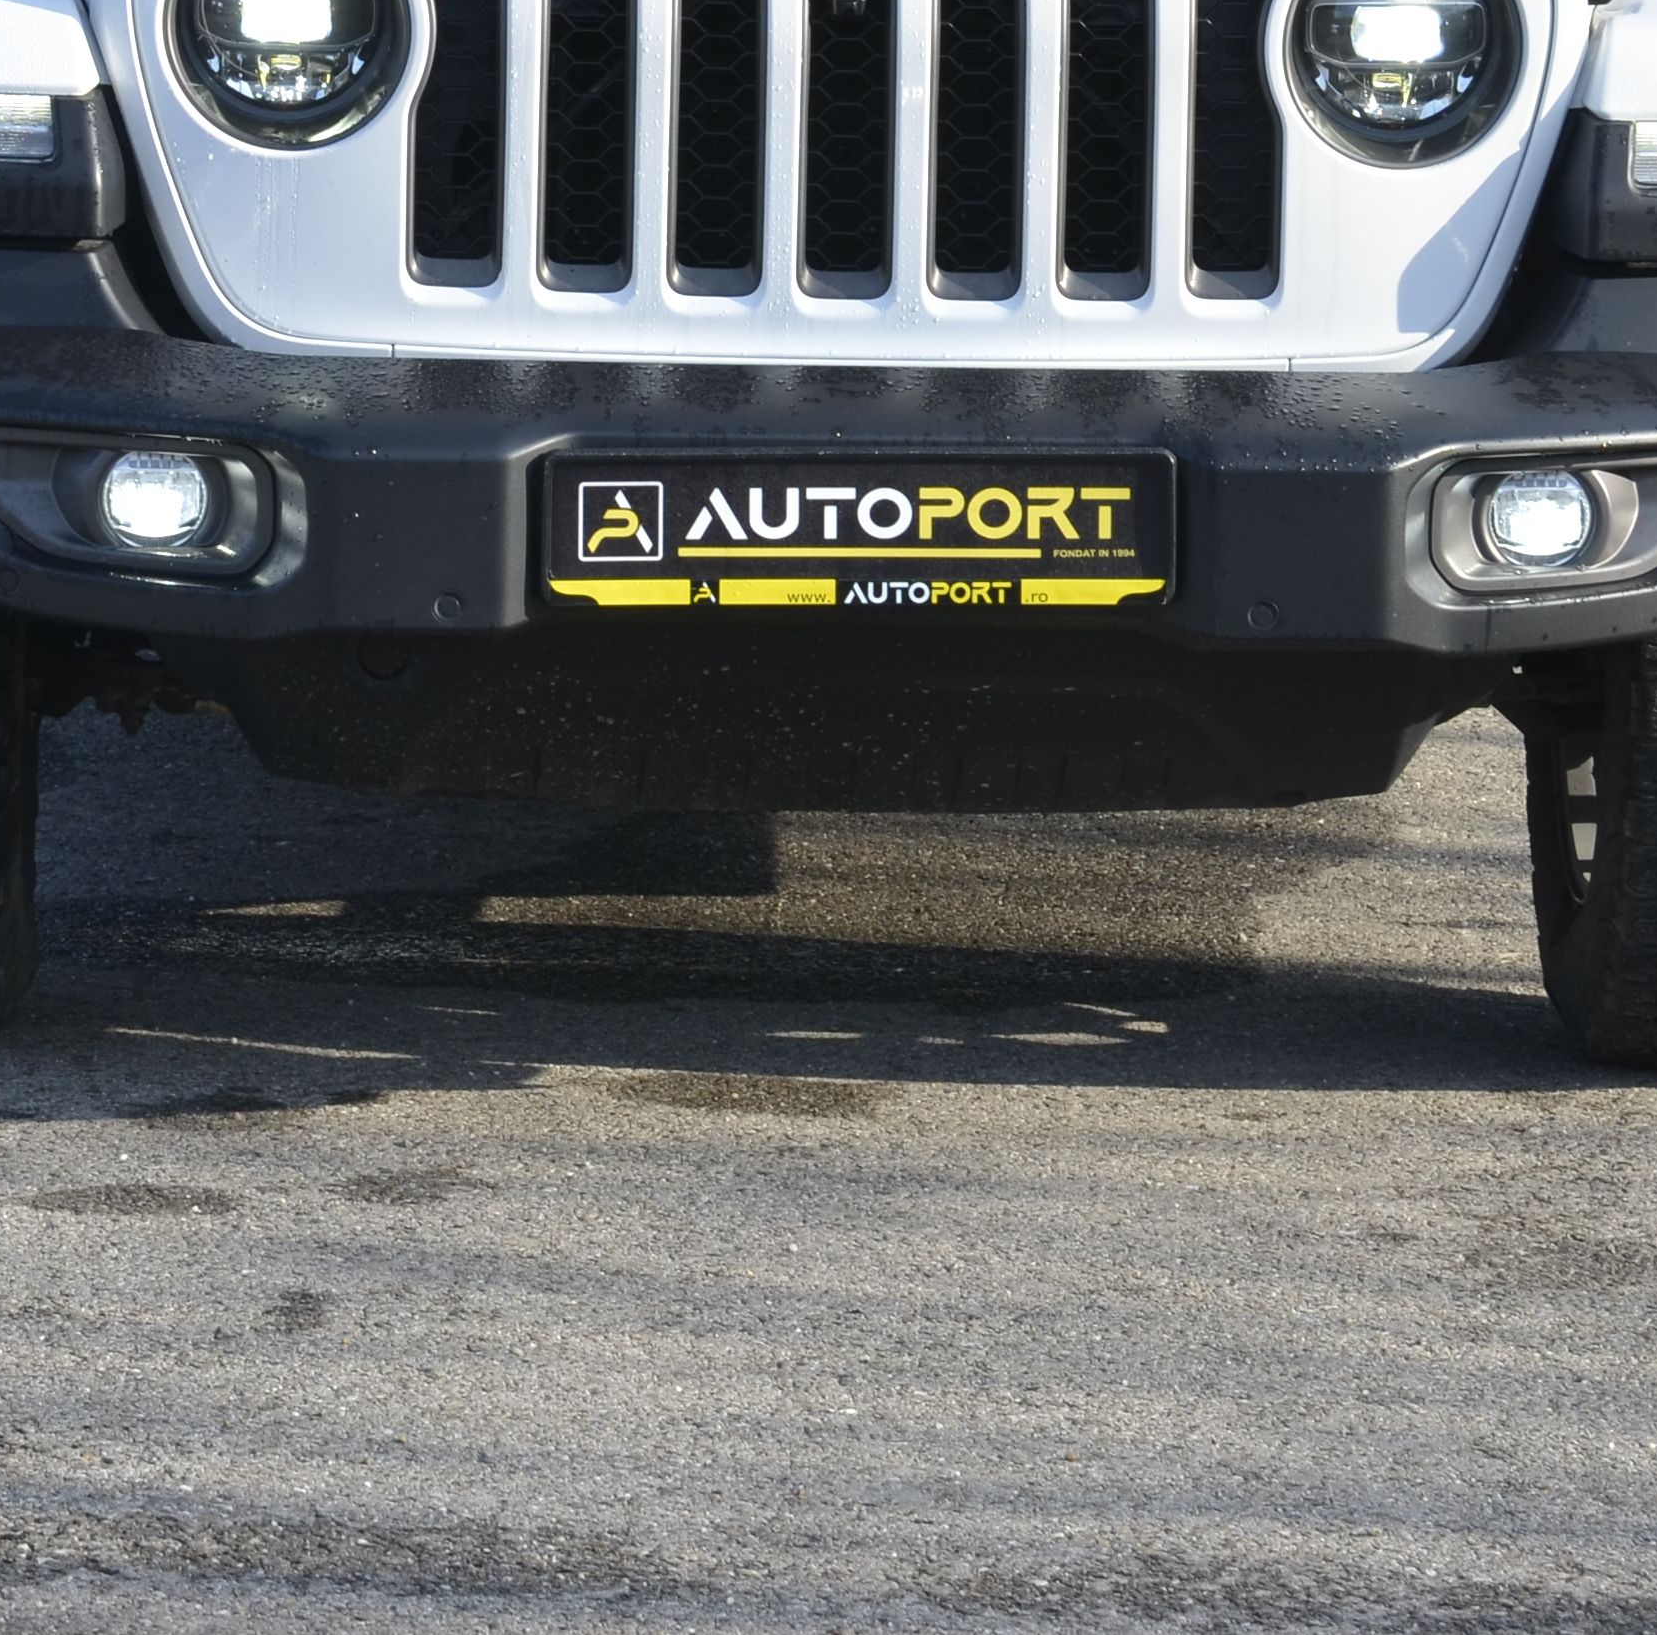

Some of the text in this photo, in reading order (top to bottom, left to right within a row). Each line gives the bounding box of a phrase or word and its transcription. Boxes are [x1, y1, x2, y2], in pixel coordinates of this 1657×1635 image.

[685, 486, 1131, 540] AUTOPORT
[1053, 548, 1136, 558] FONDAT IN 1994
[844, 580, 1012, 605] AUTOPORT
